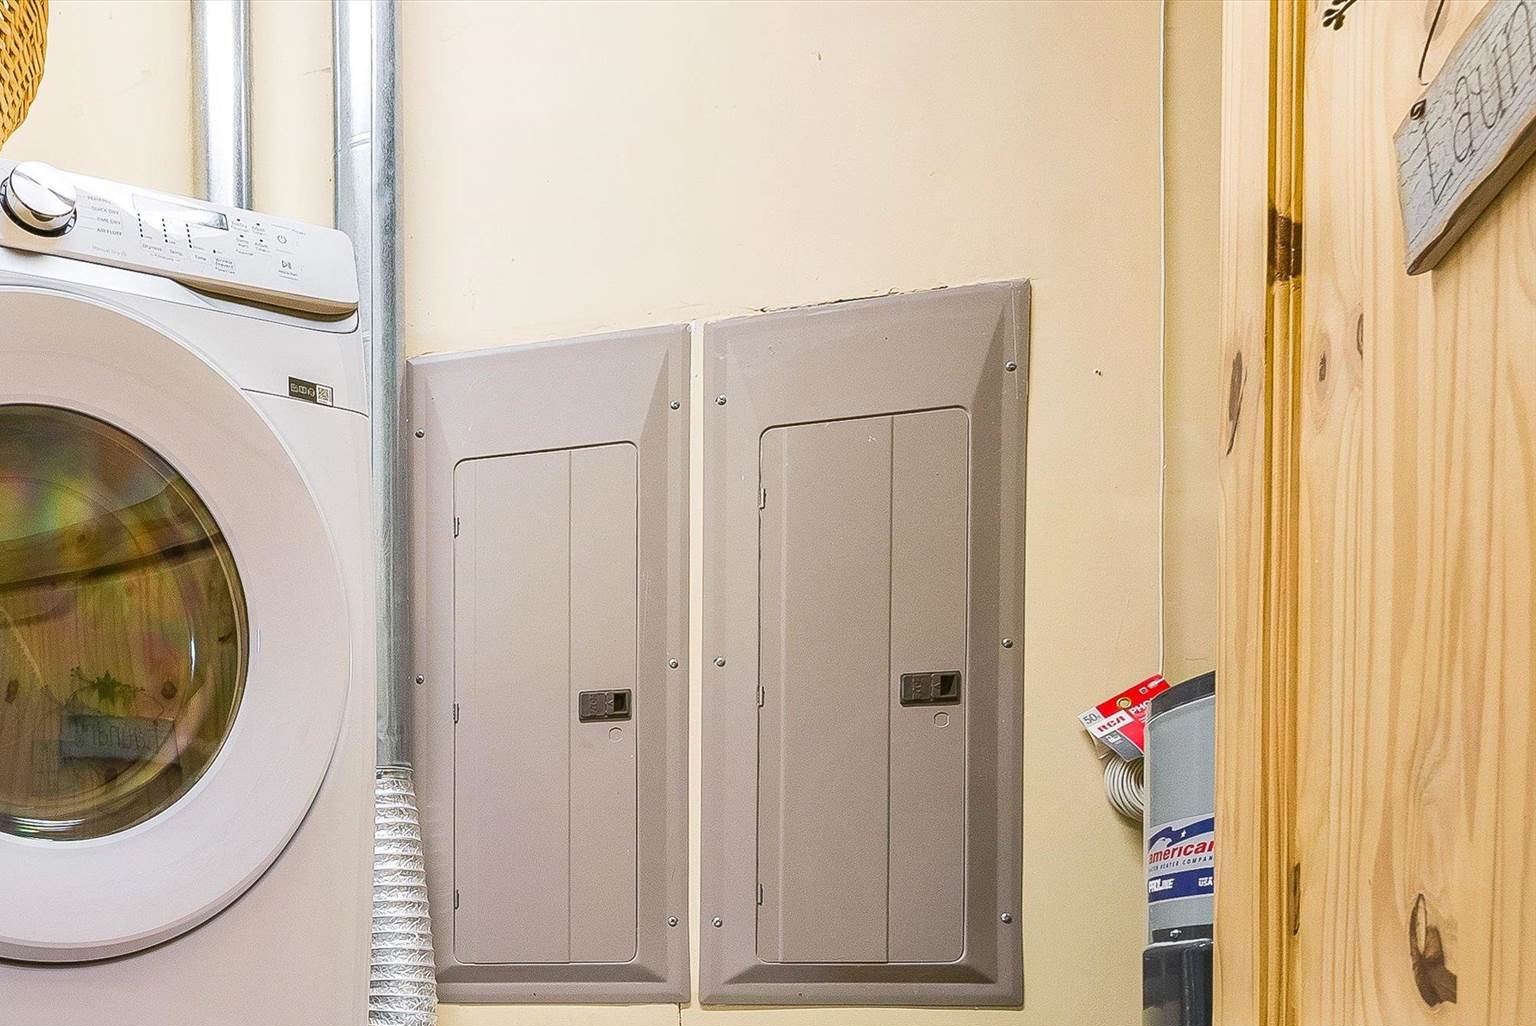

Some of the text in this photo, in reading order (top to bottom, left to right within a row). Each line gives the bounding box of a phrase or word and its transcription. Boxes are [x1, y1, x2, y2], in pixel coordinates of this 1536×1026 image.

[1083, 713, 1097, 724] 50
[1097, 716, 1125, 732] RCA
[1183, 856, 1212, 865] COMPAN
